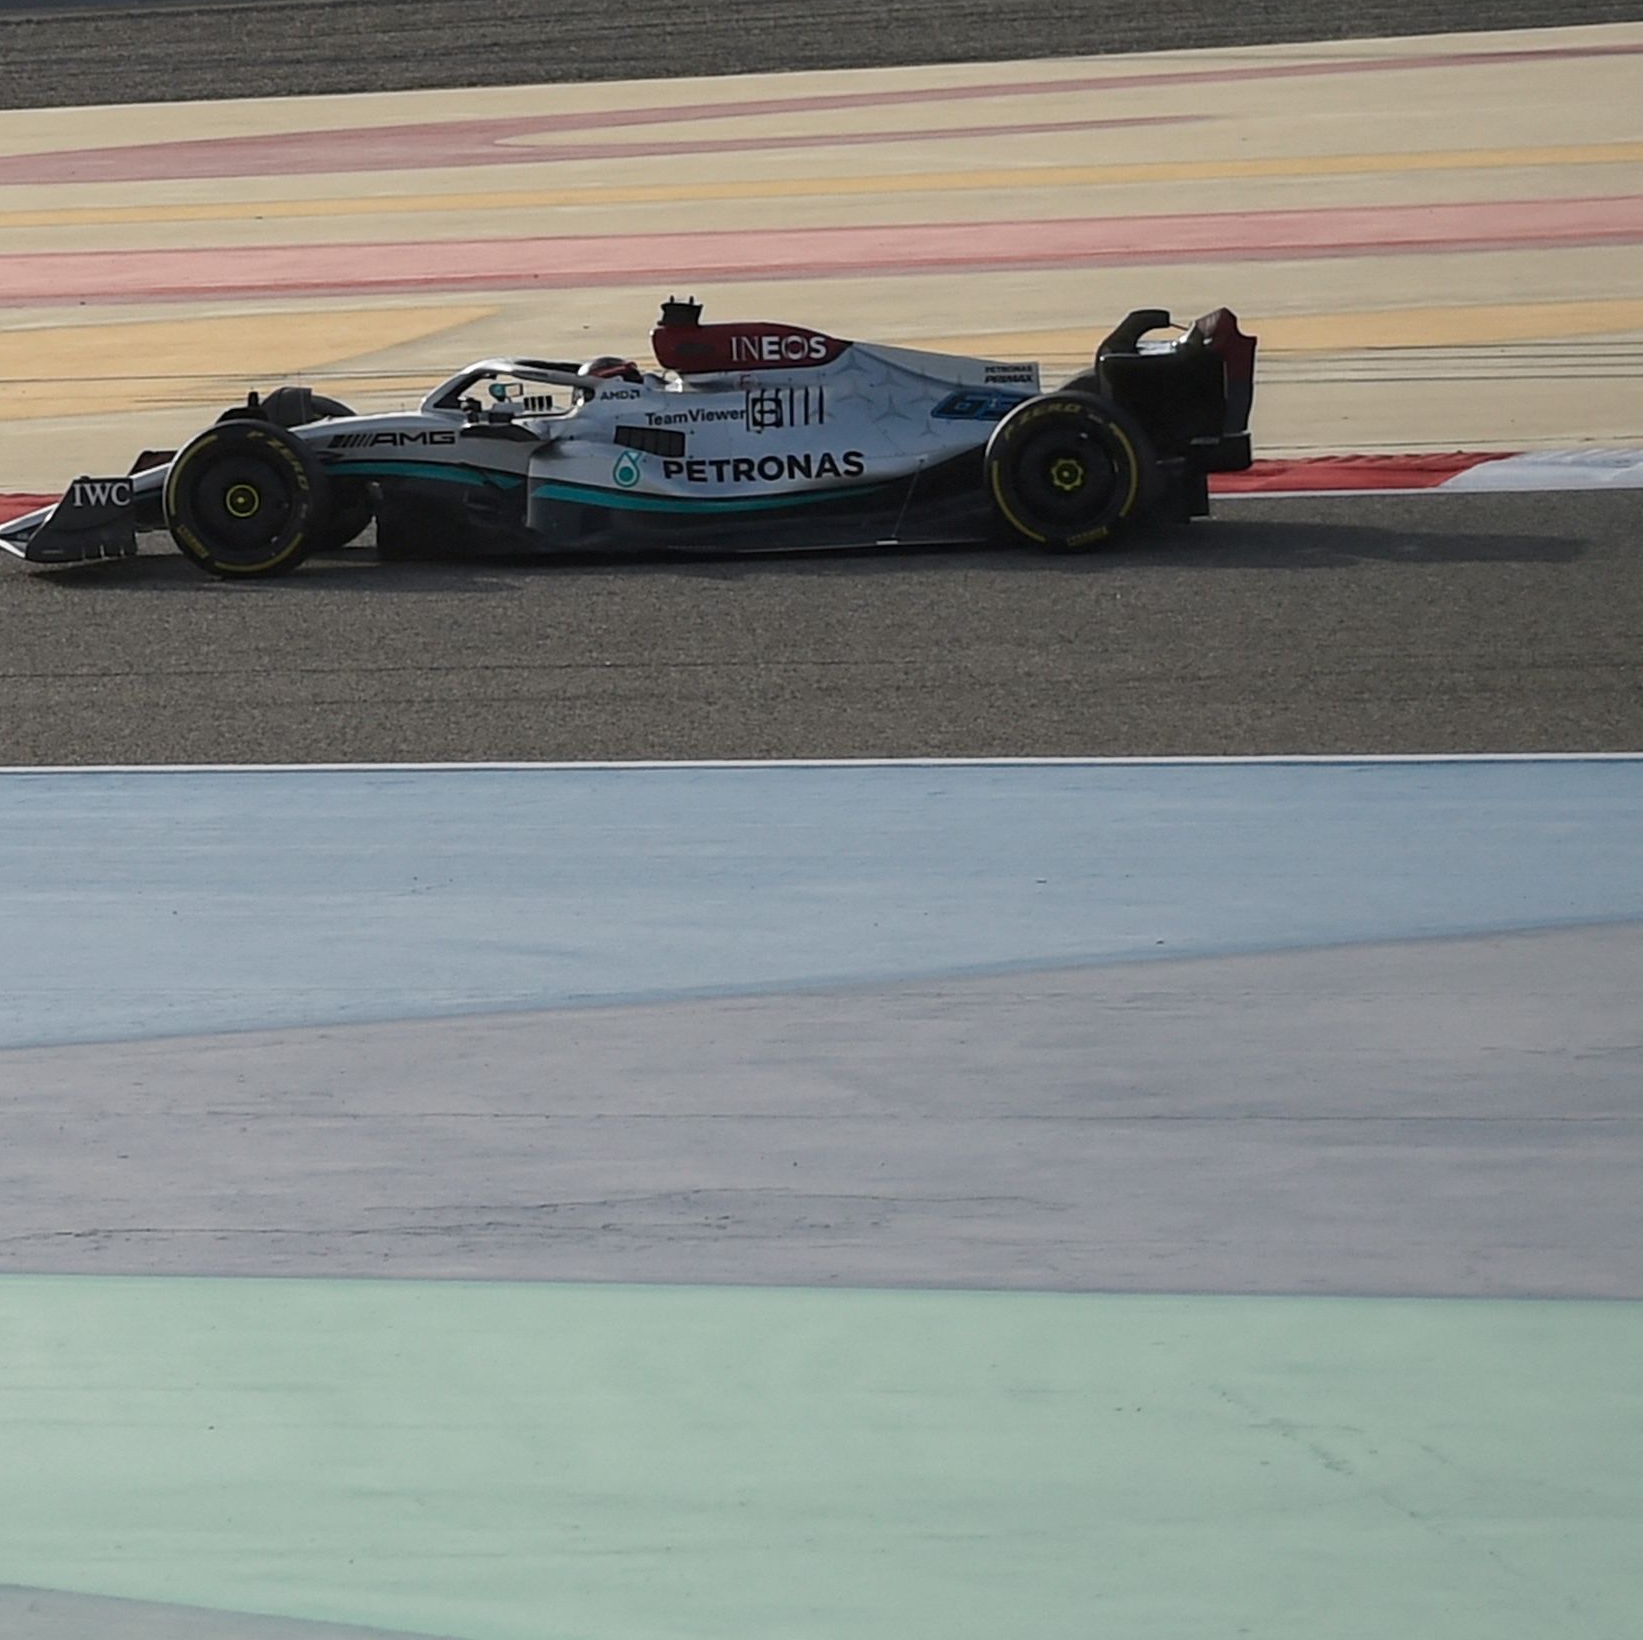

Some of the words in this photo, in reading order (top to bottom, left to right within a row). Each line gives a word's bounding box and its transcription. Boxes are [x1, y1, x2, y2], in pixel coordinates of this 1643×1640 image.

[731, 335, 827, 360] INEOS
[600, 390, 629, 400] AMD
[645, 408, 746, 426] TeamViewer
[369, 431, 456, 446] AMG
[663, 451, 864, 483] PETRONAS
[73, 483, 131, 507] IWC
